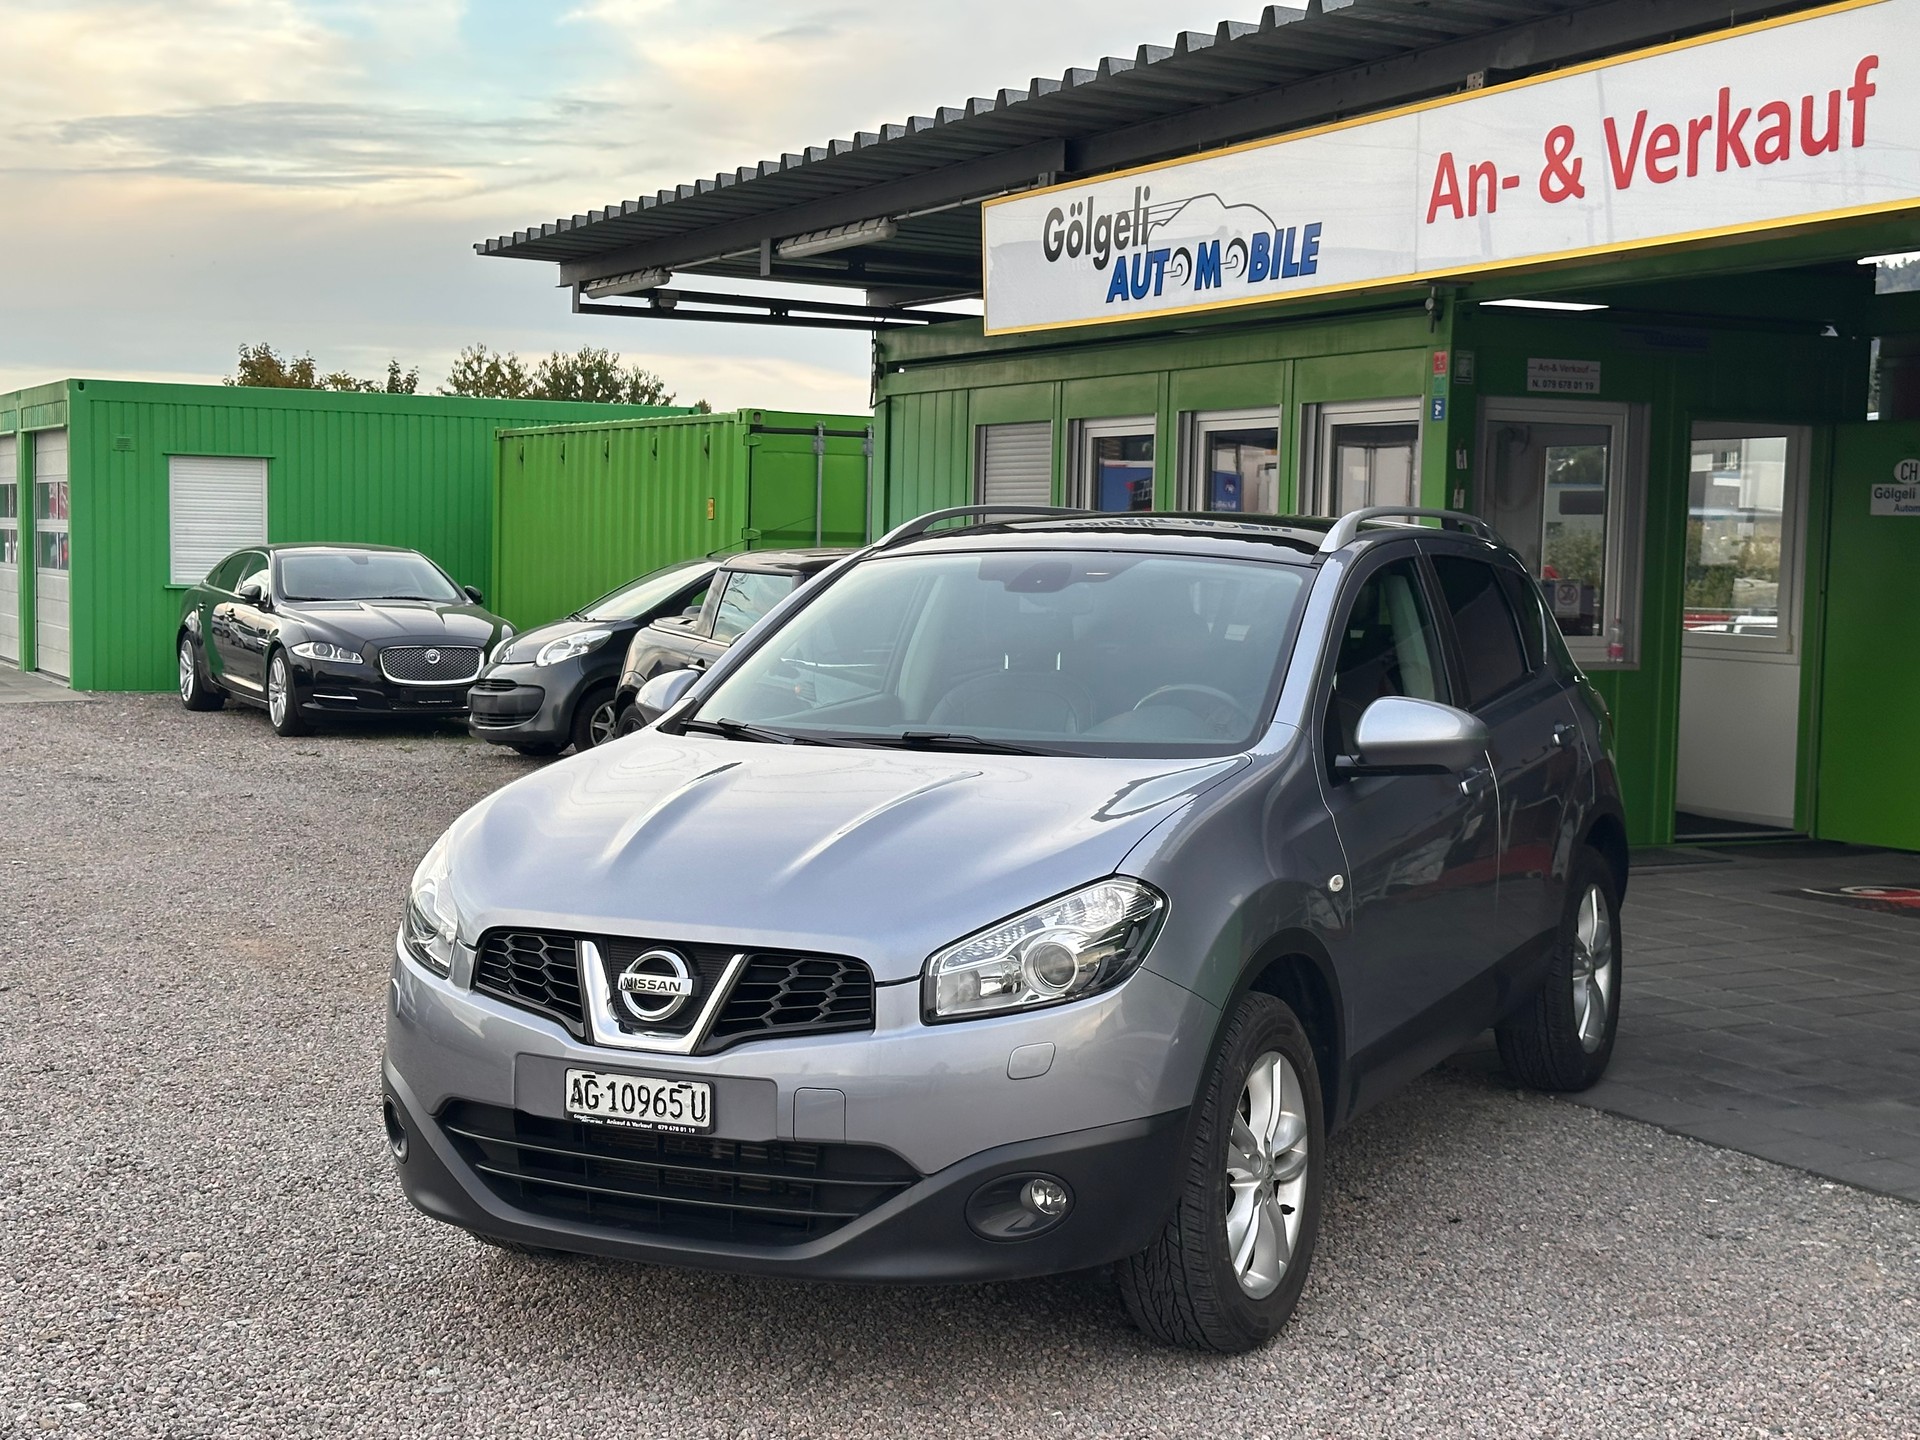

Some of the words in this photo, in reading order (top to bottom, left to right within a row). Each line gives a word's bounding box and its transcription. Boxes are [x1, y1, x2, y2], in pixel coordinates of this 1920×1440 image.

[1426, 151, 1520, 224] An-
[1538, 124, 1585, 204] &
[1603, 54, 1880, 190] Verkauf
[1043, 185, 1151, 270] Gölgeli
[1543, 380, 1556, 389] 079
[1559, 380, 1572, 389] 678
[1573, 381, 1583, 390] 01
[1585, 381, 1594, 390] 19
[1900, 462, 1918, 481] CH
[1874, 486, 1916, 502] Gölgeli
[620, 976, 682, 993] NISSAN
